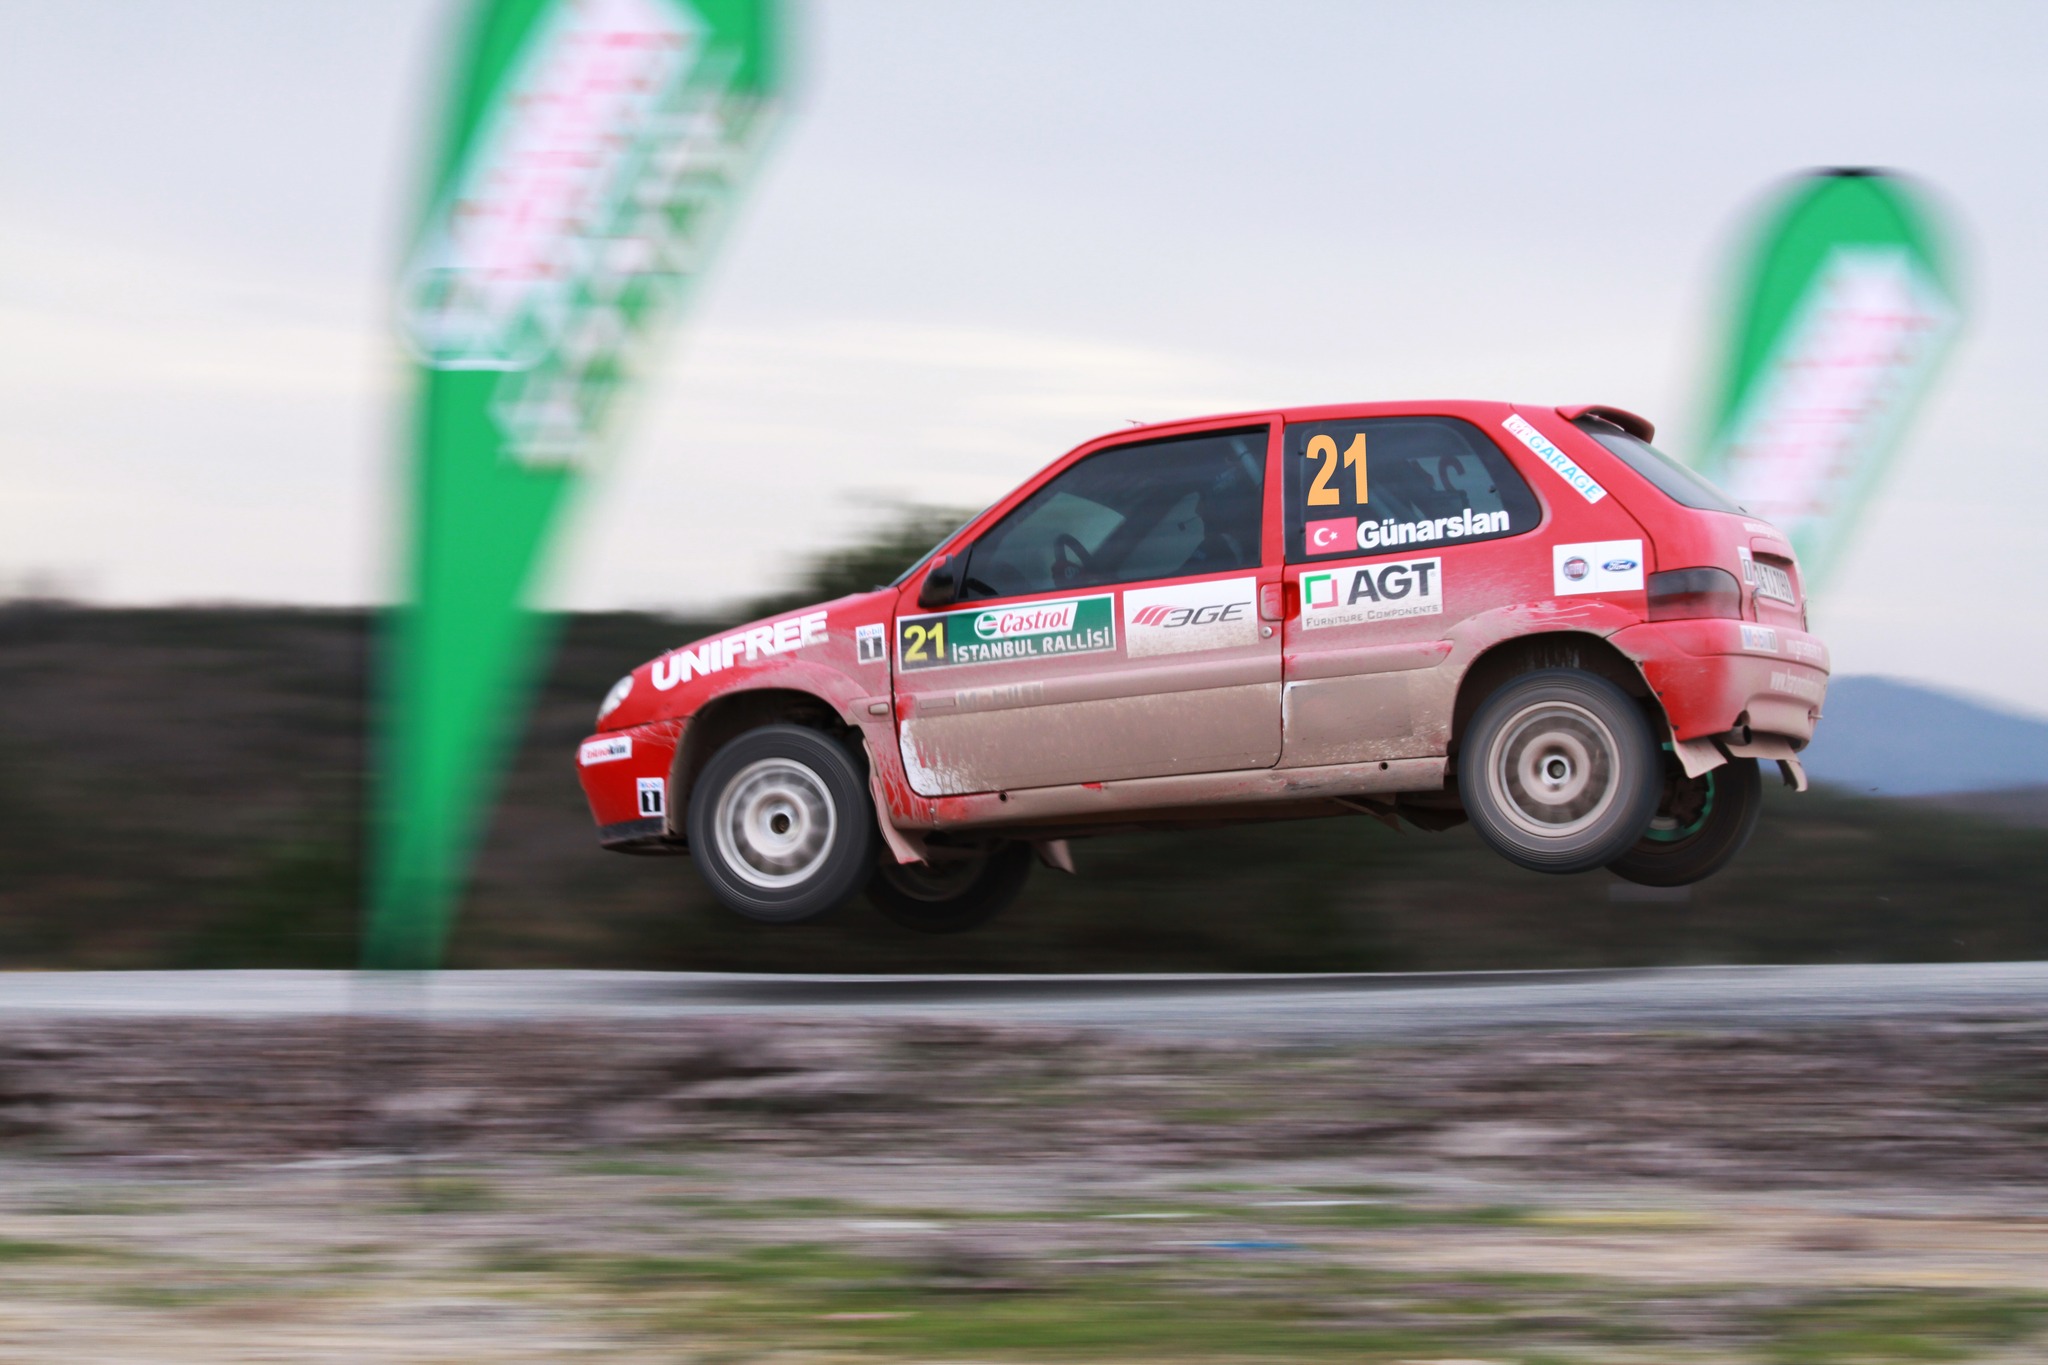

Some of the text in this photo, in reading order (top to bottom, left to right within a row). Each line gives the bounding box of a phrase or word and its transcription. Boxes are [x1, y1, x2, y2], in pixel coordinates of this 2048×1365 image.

[1305, 432, 1369, 506] 21
[1529, 435, 1602, 499] GARAGE
[1356, 508, 1511, 549] Günarslan
[1347, 561, 1435, 605] AGT
[1000, 607, 1070, 634] Castrol
[650, 611, 829, 692] UNIFREE
[865, 637, 875, 659] 1
[903, 621, 945, 664] 21
[951, 626, 1110, 663] İSTANBUL RALLİSİ
[645, 791, 655, 813] 1
